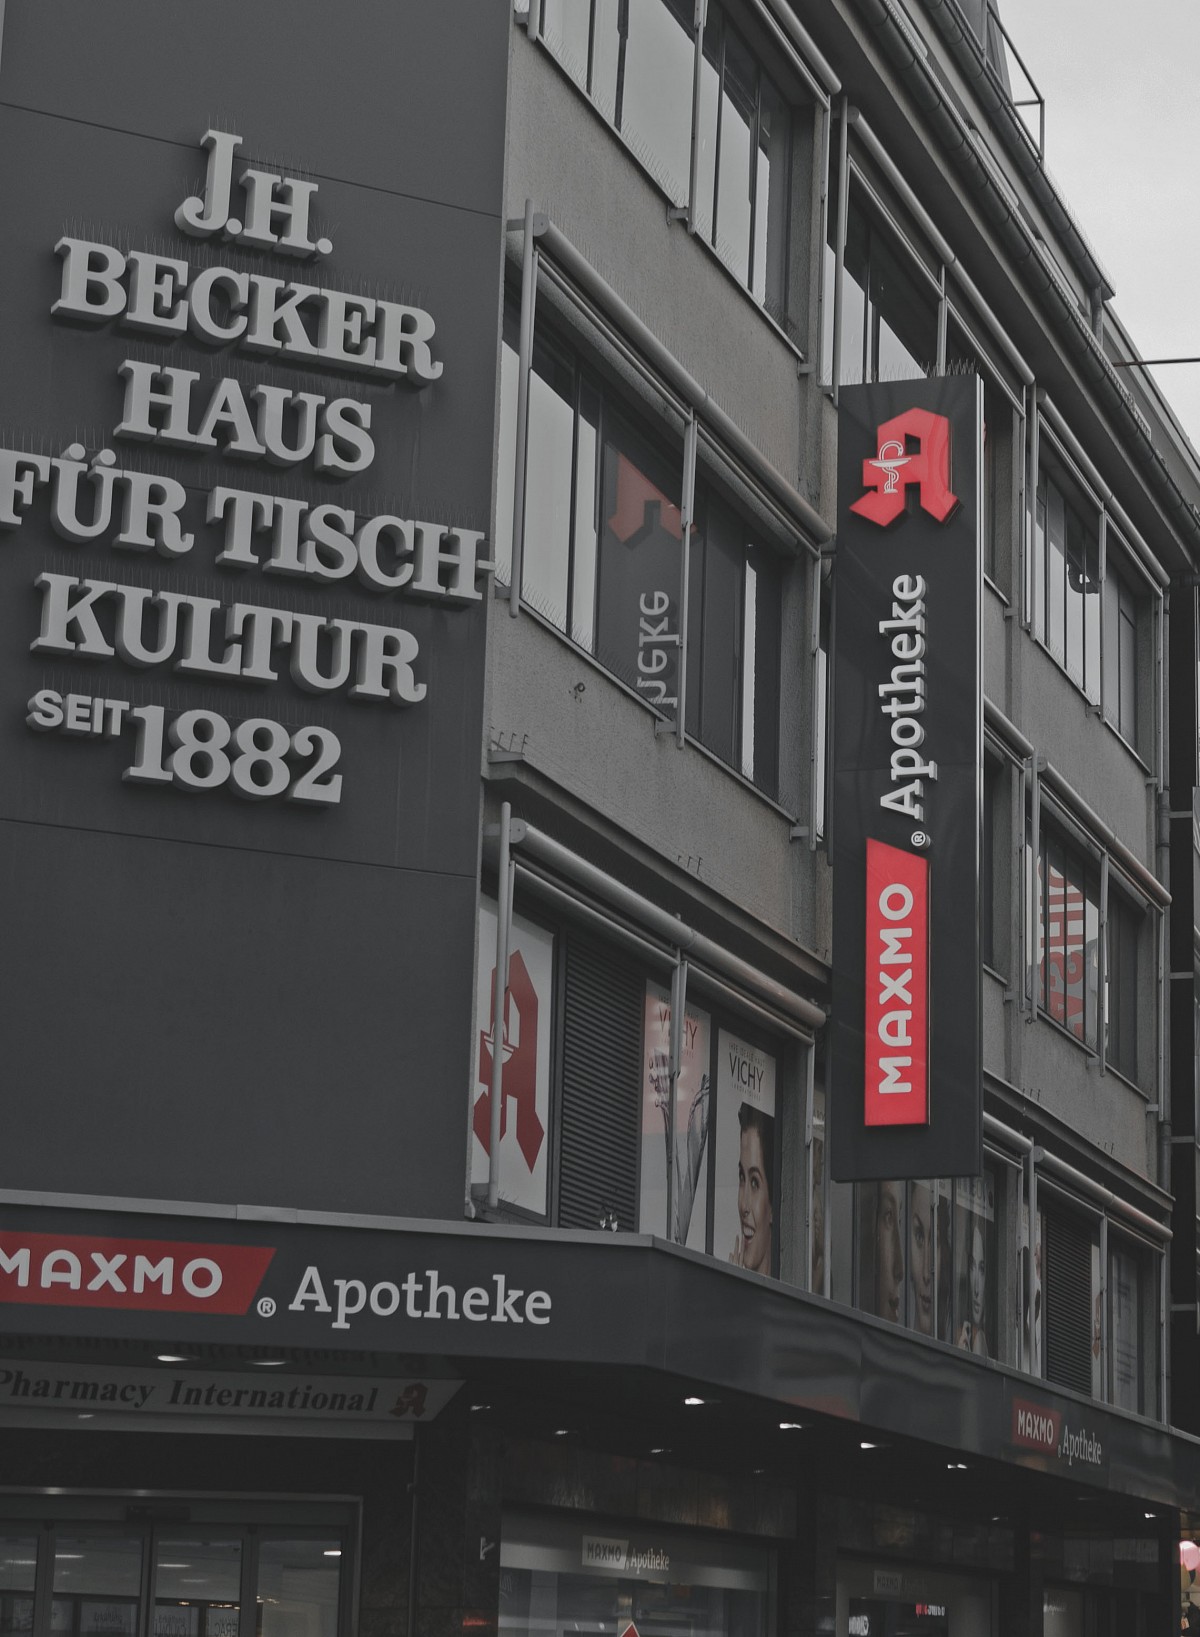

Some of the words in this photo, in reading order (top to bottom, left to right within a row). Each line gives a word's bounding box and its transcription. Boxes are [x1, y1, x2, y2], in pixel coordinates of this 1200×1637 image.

[50, 236, 444, 386] BECKER
[112, 360, 375, 478] HAUS
[0, 441, 195, 558] FÜR
[206, 486, 496, 600] TISCH-
[29, 571, 427, 703] KULTUR
[26, 689, 130, 737] SEIT
[122, 705, 343, 804] 1882
[879, 574, 938, 821] Apotheke
[659, 1006, 698, 1050] VIHY
[877, 883, 914, 1094] MAXMO
[729, 1052, 764, 1093] VICHY
[0, 1246, 224, 1299] MAXMO
[289, 1265, 553, 1329] Apotheke
[0, 1369, 156, 1409] Pharmacy
[168, 1379, 380, 1413] International
[1017, 1409, 1054, 1445] MAXMO
[1062, 1425, 1102, 1466] Apotheke
[587, 1543, 622, 1562] MAXMO
[630, 1547, 670, 1575] Apotheke
